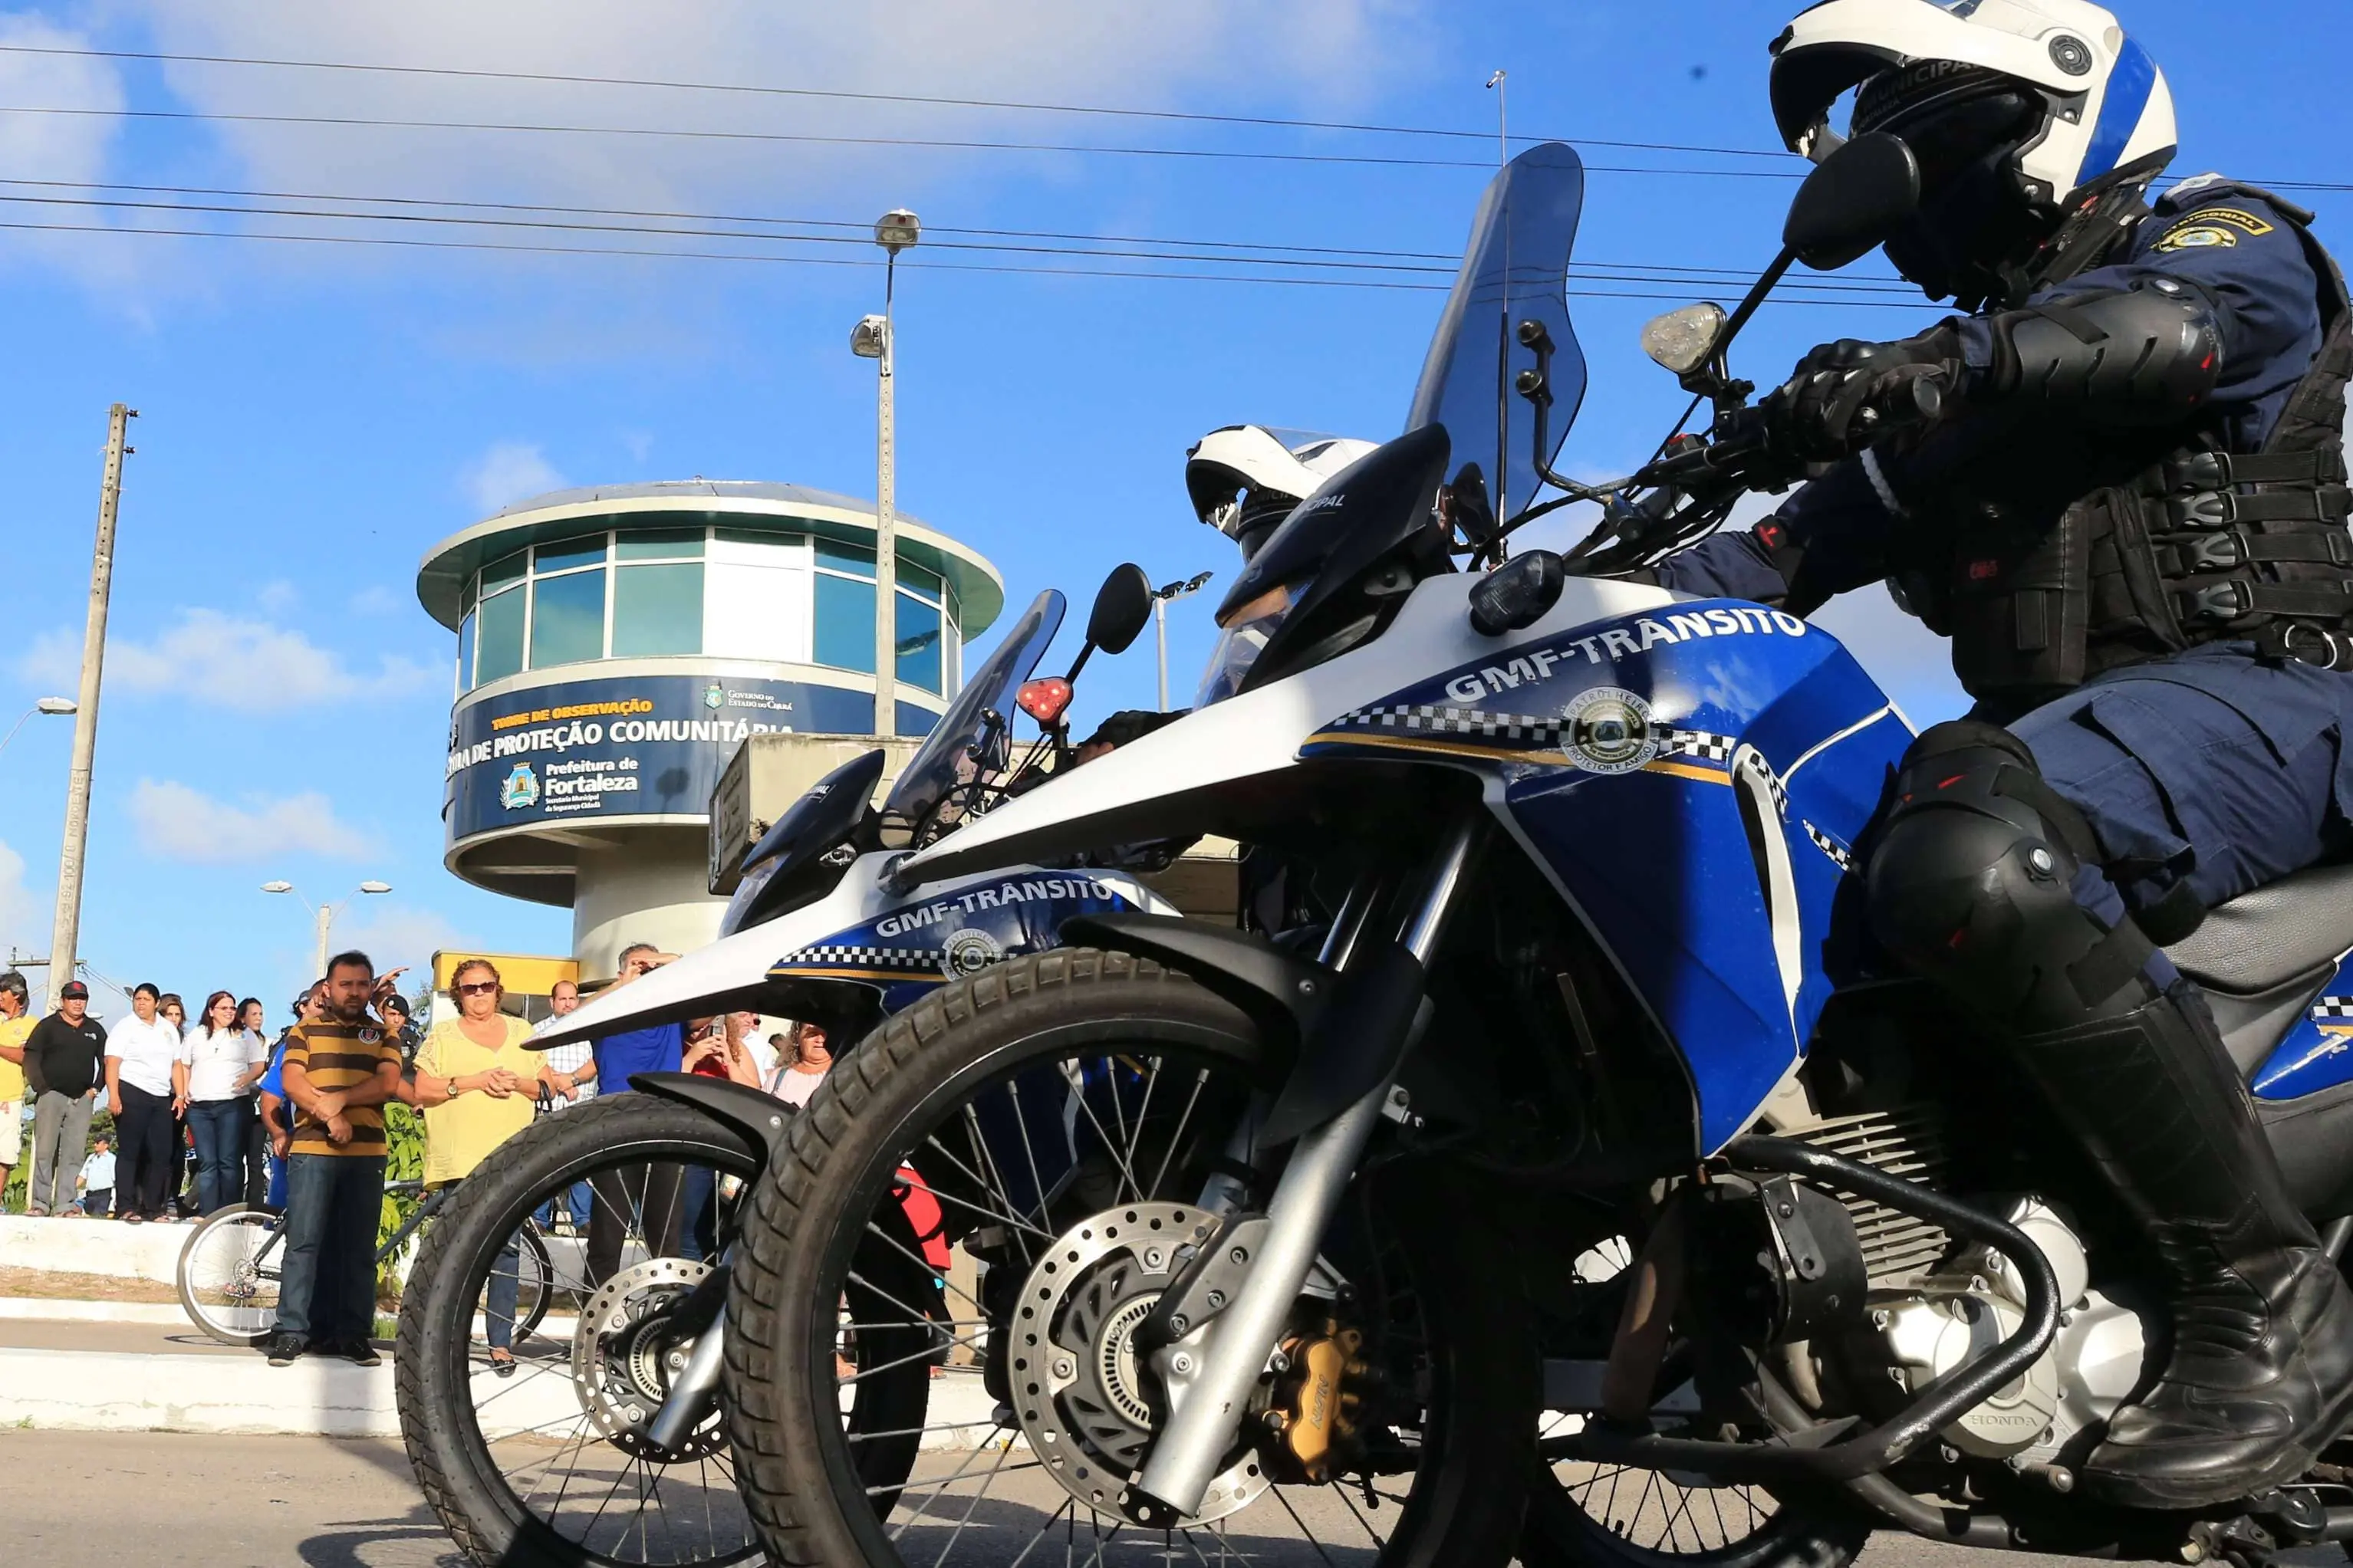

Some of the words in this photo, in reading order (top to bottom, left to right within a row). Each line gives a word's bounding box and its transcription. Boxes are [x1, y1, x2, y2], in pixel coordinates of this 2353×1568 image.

[1863, 59, 1982, 113] MUNICIPA
[1445, 607, 1807, 703] GMF-TRÂNSITO
[531, 708, 550, 722] DE
[552, 697, 653, 720] OBSERVAÇÃO
[472, 739, 492, 765] DE
[493, 720, 603, 758] PROTEÇÃO
[545, 760, 615, 777] Prefeitura
[618, 757, 639, 771] de
[1625, 745, 1652, 768] AMIGO
[545, 773, 638, 797] Fortaleza
[876, 879, 1112, 938] GMF-TRÂNSITO
[1968, 1414, 2038, 1428] HONDA
